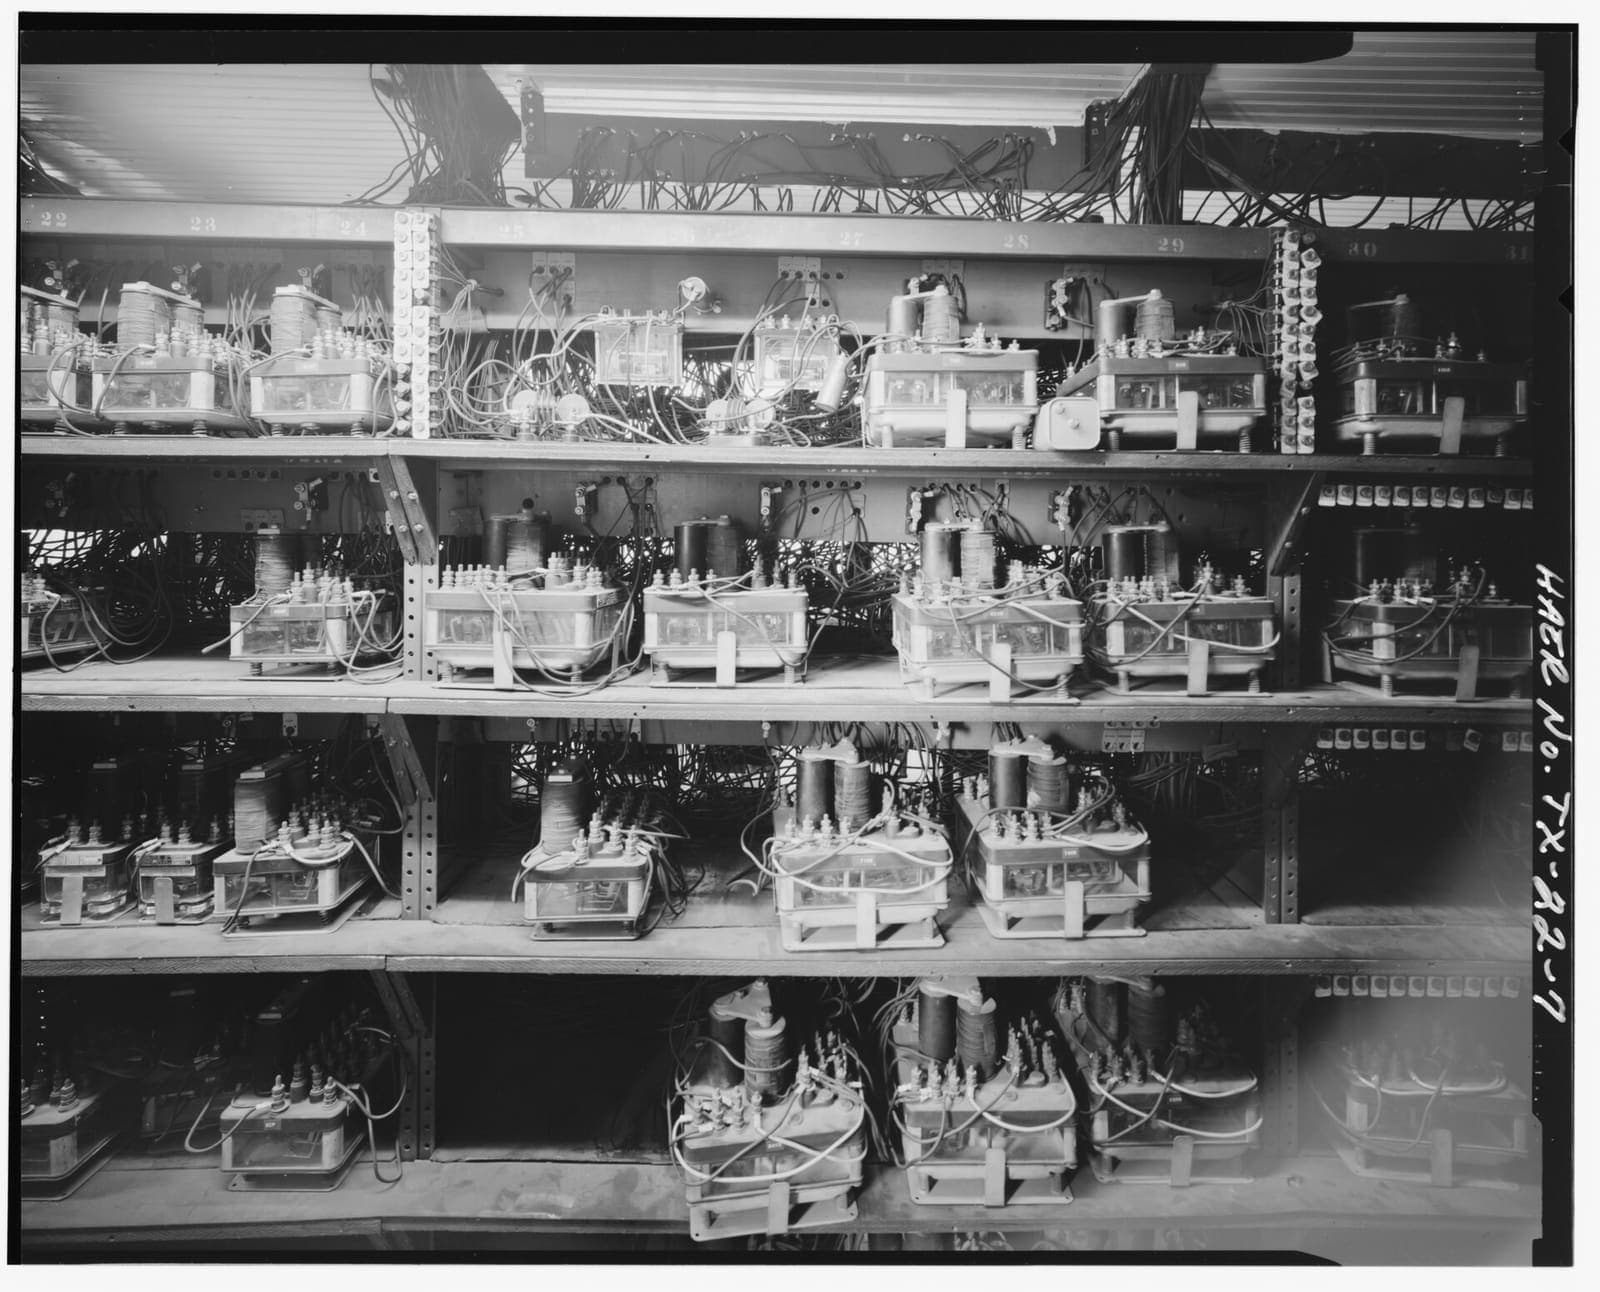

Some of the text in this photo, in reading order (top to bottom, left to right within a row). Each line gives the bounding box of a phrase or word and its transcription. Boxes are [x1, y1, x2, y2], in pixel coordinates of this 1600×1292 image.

[40, 211, 67, 228] 22
[190, 216, 216, 232] 23
[340, 220, 366, 237] 24
[840, 232, 865, 247] 27
[1004, 234, 1029, 250] 28
[1158, 237, 1184, 253] 29
